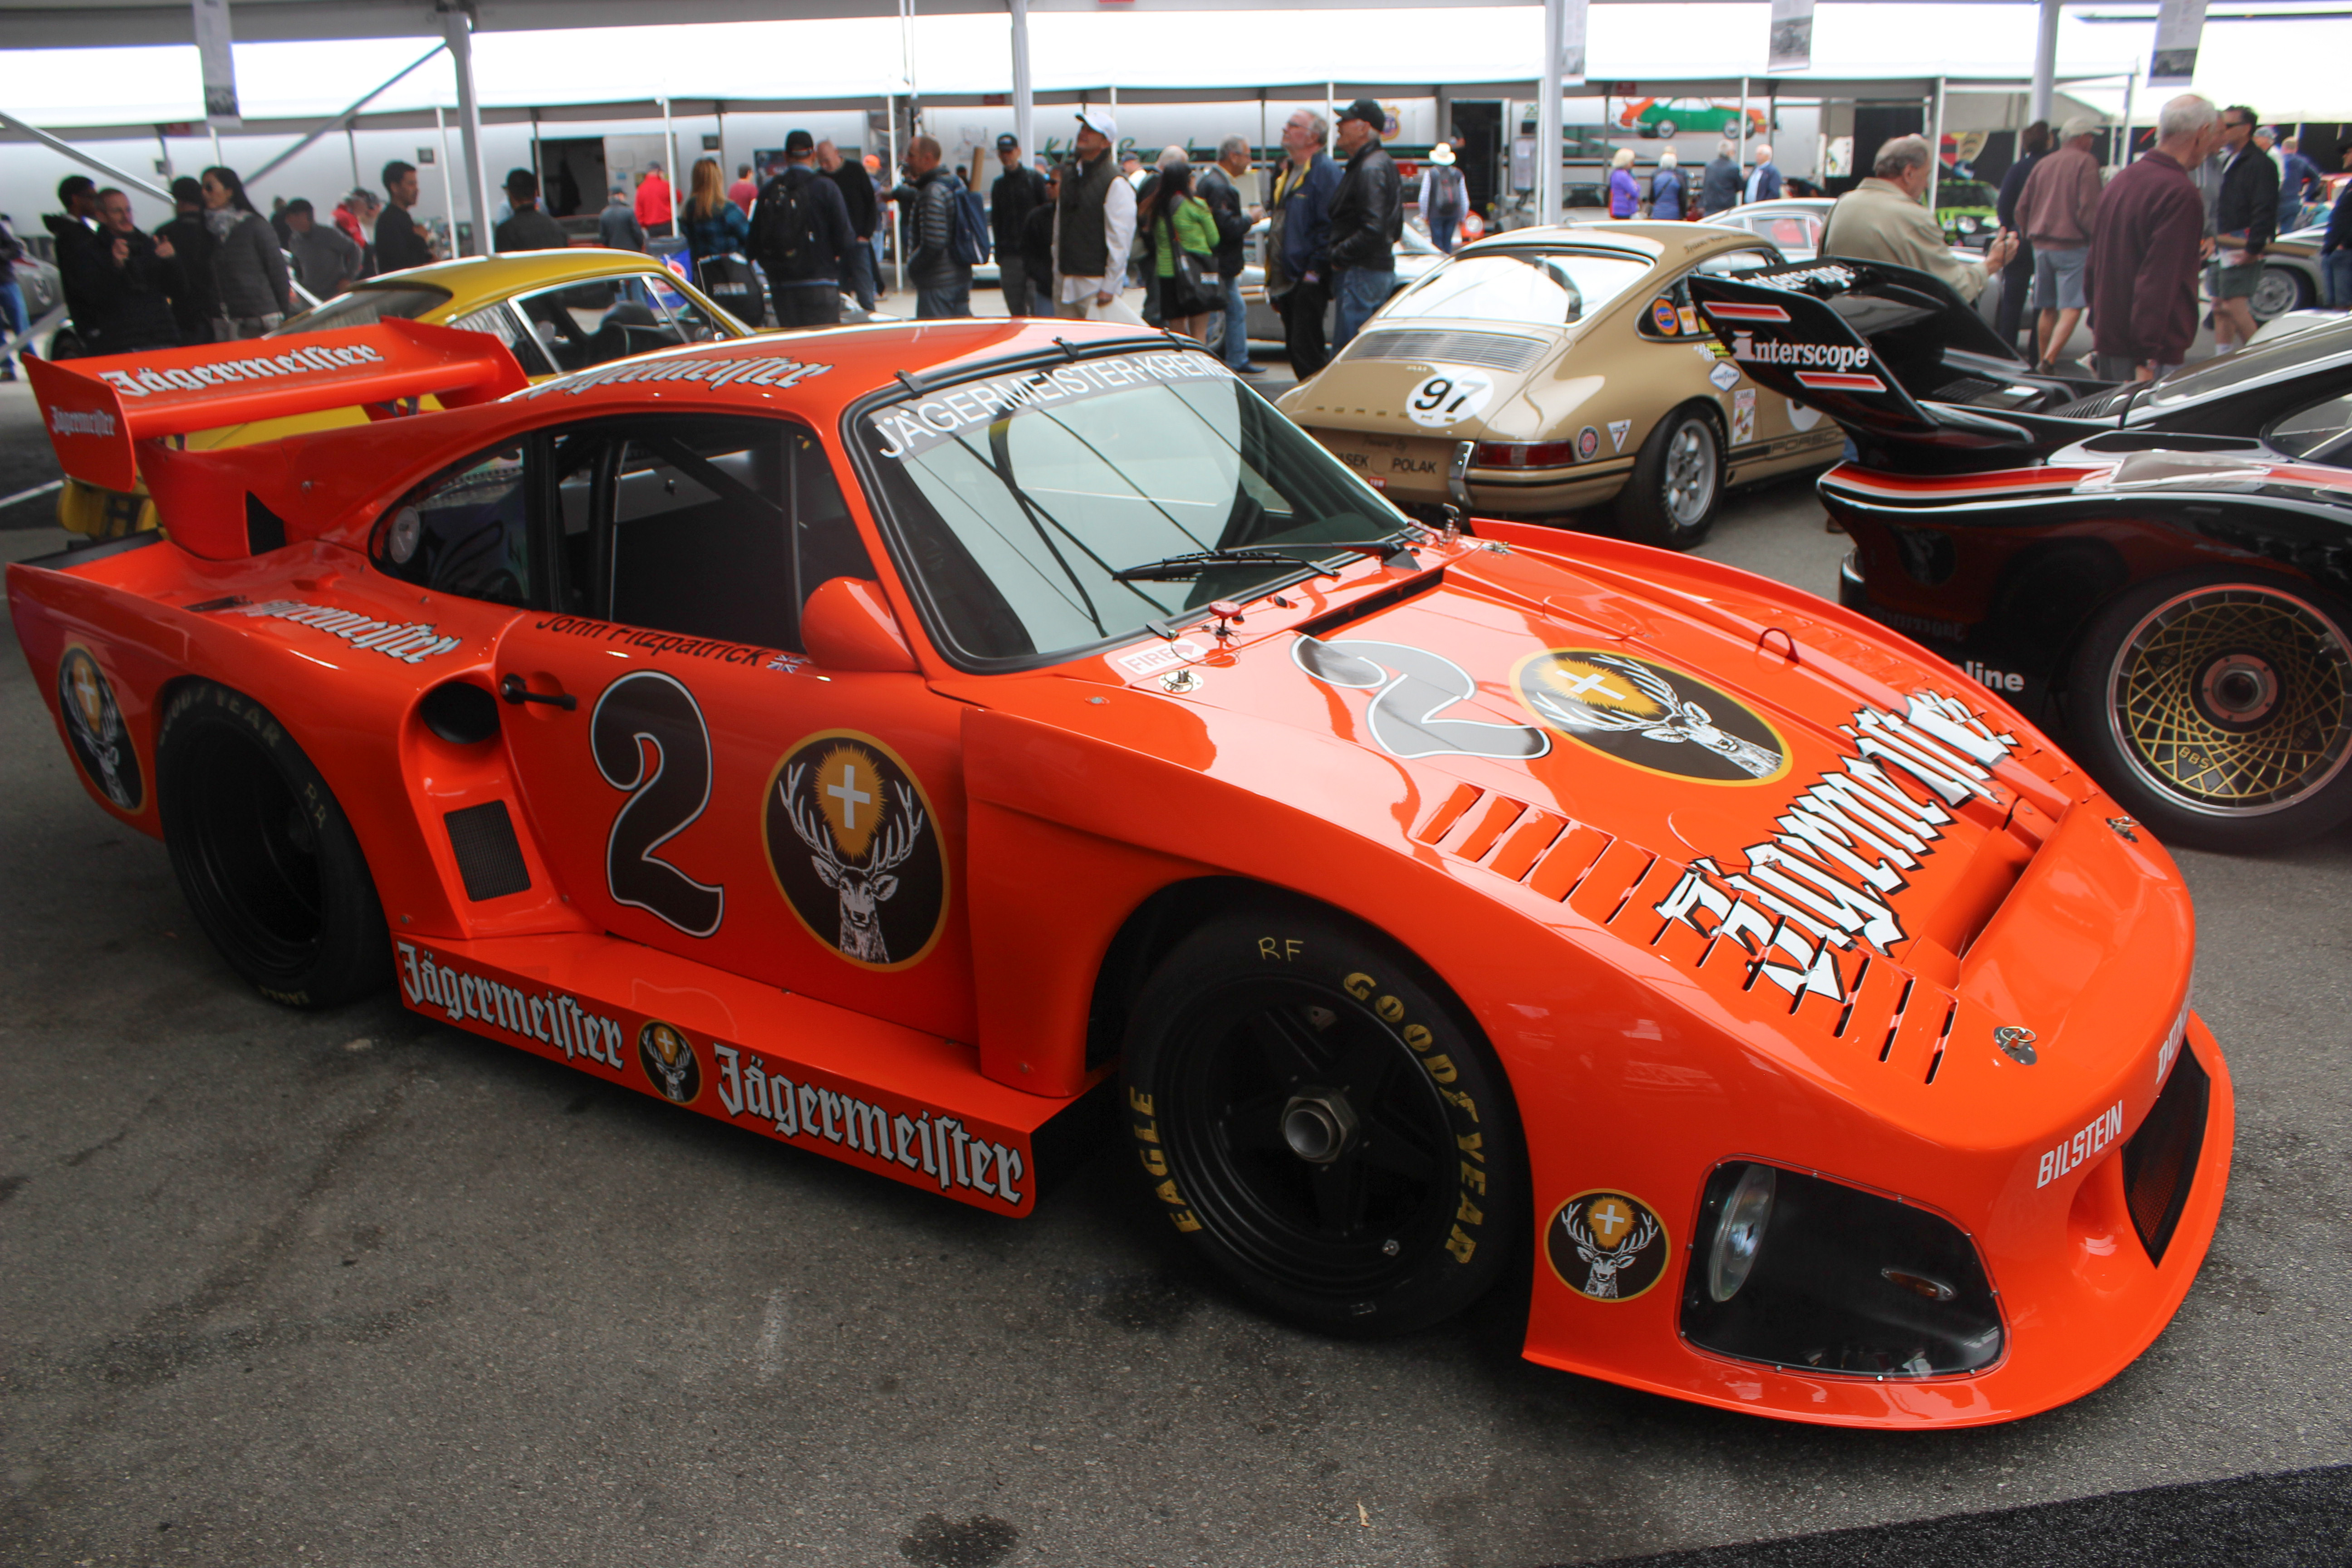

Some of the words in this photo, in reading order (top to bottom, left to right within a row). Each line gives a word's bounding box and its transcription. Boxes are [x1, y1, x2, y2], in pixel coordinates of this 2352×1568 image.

[1414, 377, 1489, 413] 97
[1392, 457, 1437, 473] POLAK
[1125, 646, 1174, 672] FIRE
[1290, 633, 1552, 760] 2
[2179, 746, 2210, 769] BBS
[589, 669, 726, 939] 2
[1259, 936, 1304, 961] RF
[1129, 1085, 1203, 1233] EAGLE
[2035, 1098, 2124, 1189] BILSTEIN
